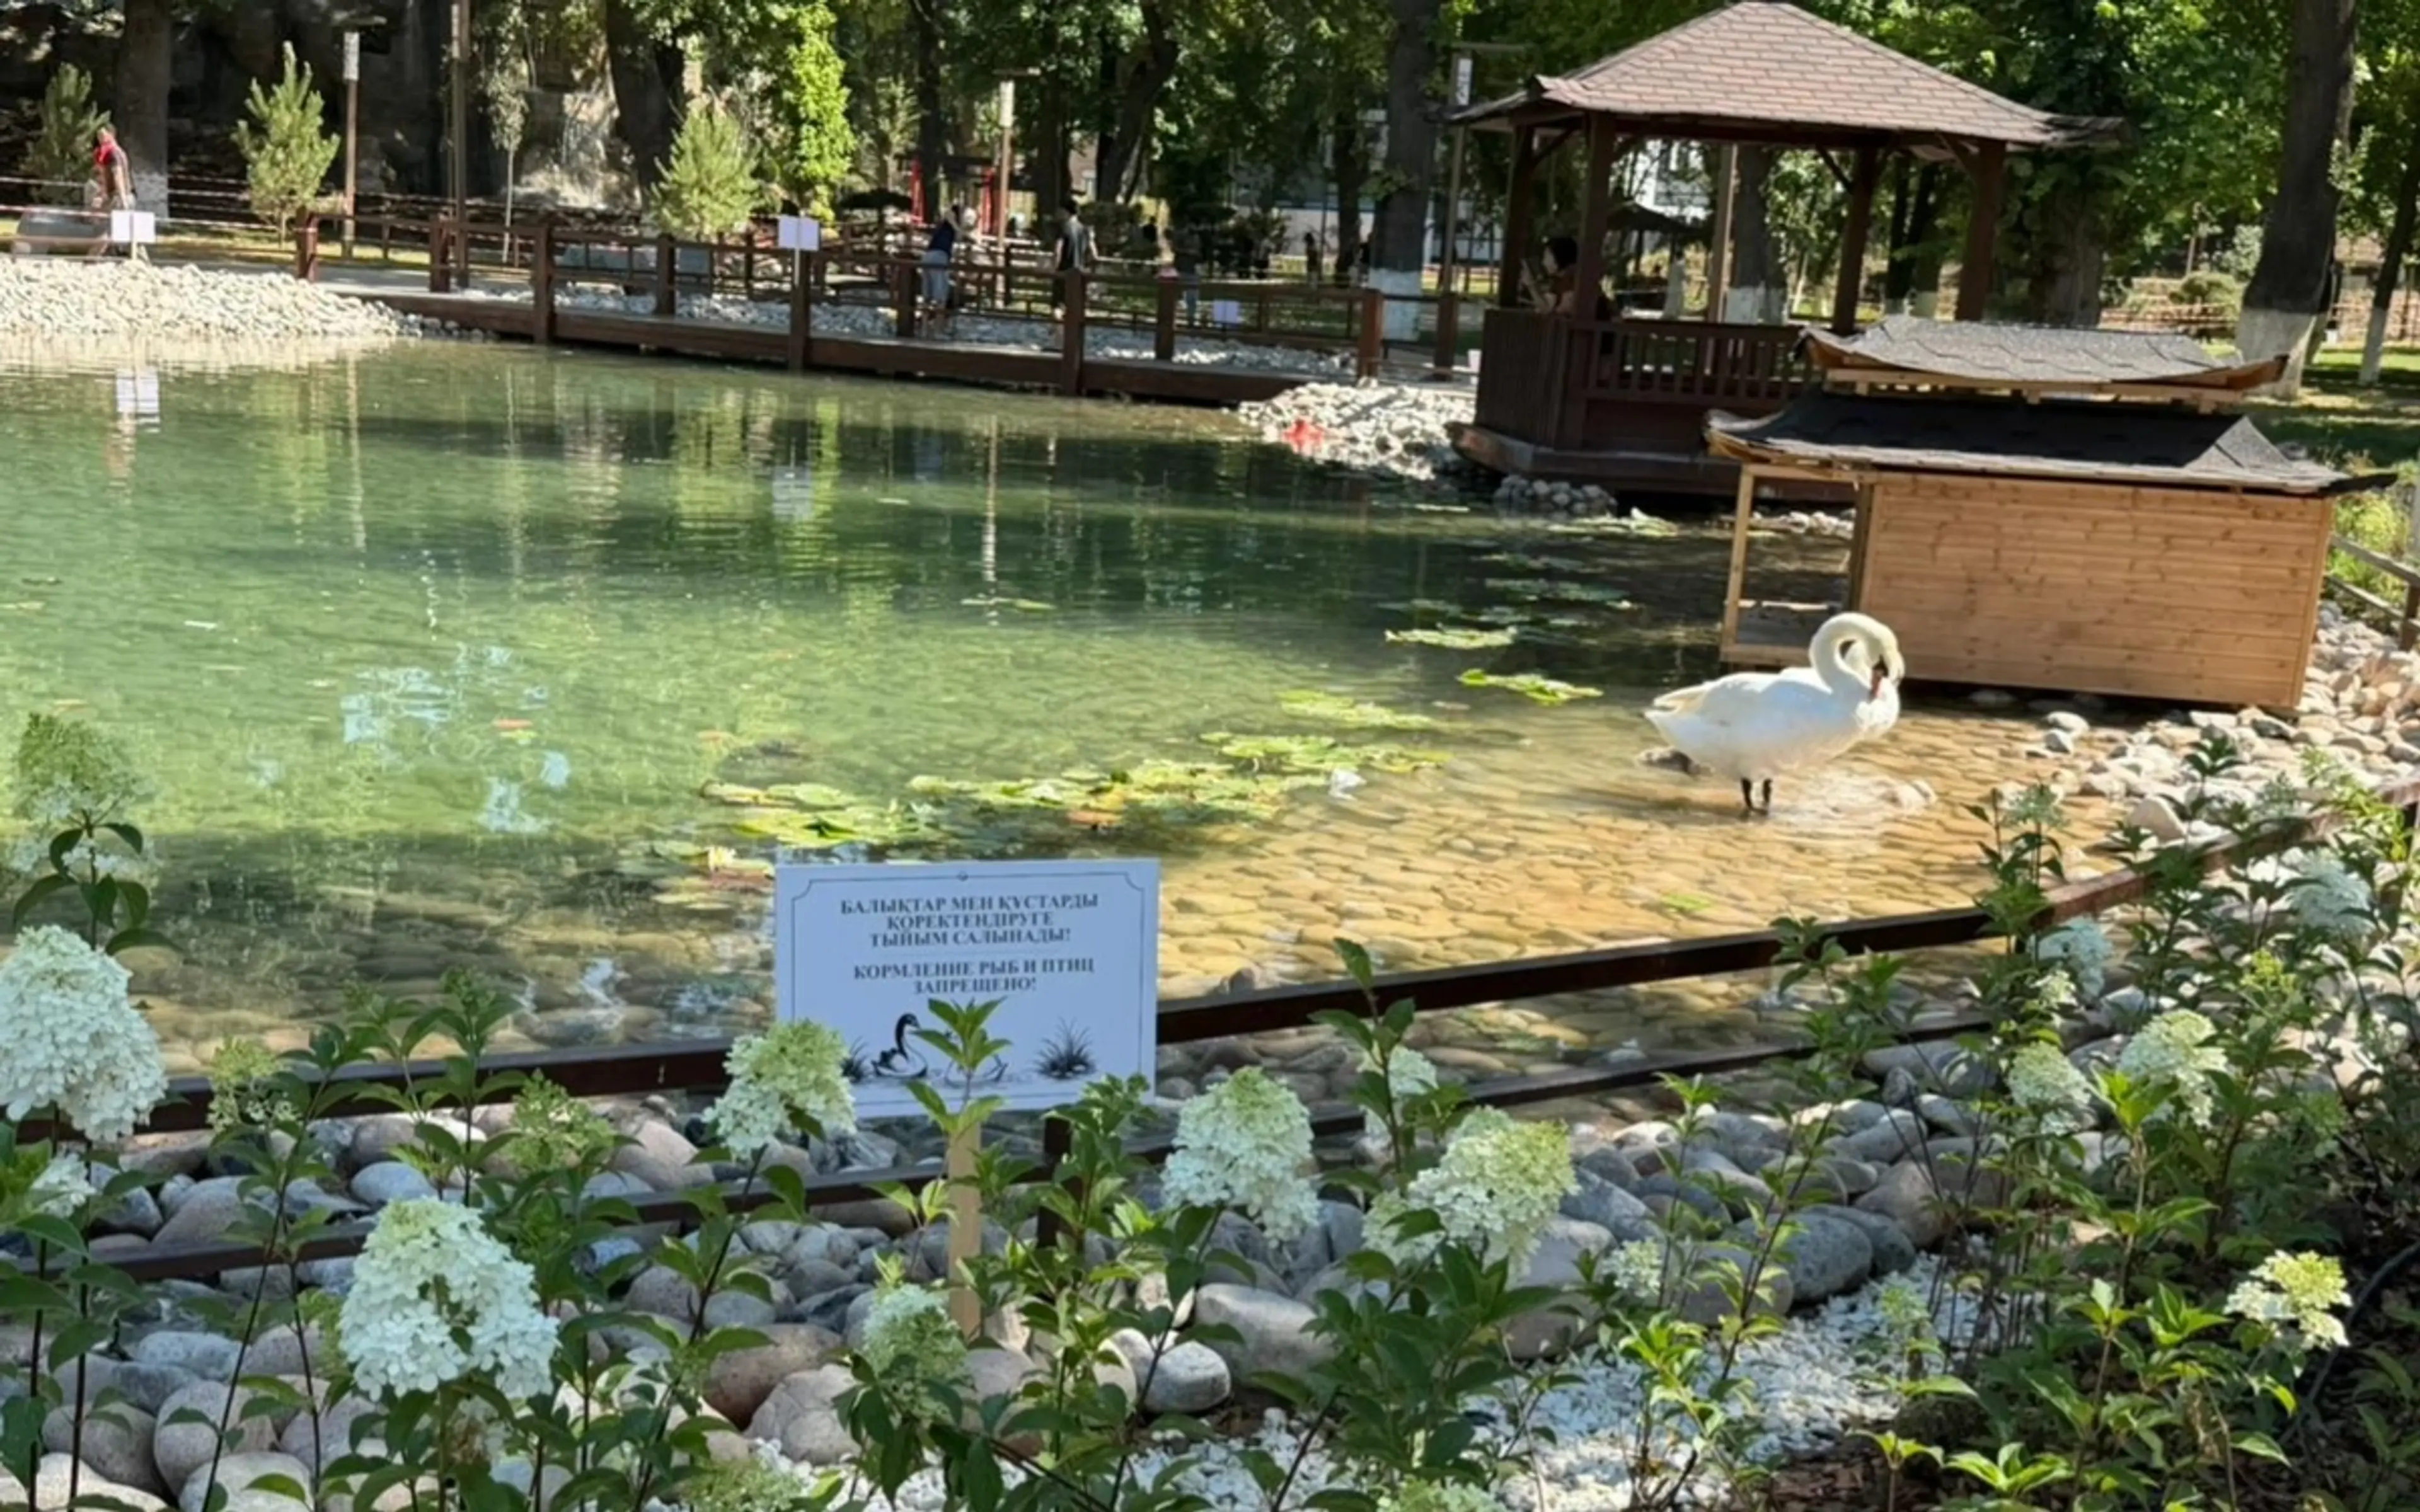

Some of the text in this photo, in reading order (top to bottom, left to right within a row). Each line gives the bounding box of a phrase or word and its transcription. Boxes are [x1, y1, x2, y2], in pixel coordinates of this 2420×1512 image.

[952, 896, 993, 910] МЕН
[870, 927, 1071, 947] ТЫЙЫМ САЛЫНАДЫ!
[854, 958, 1095, 979] КОРМЛЕНИЕ РЫБ И ПТИЦ
[913, 976, 1036, 994] ЗАПРЕЩЕНО!
